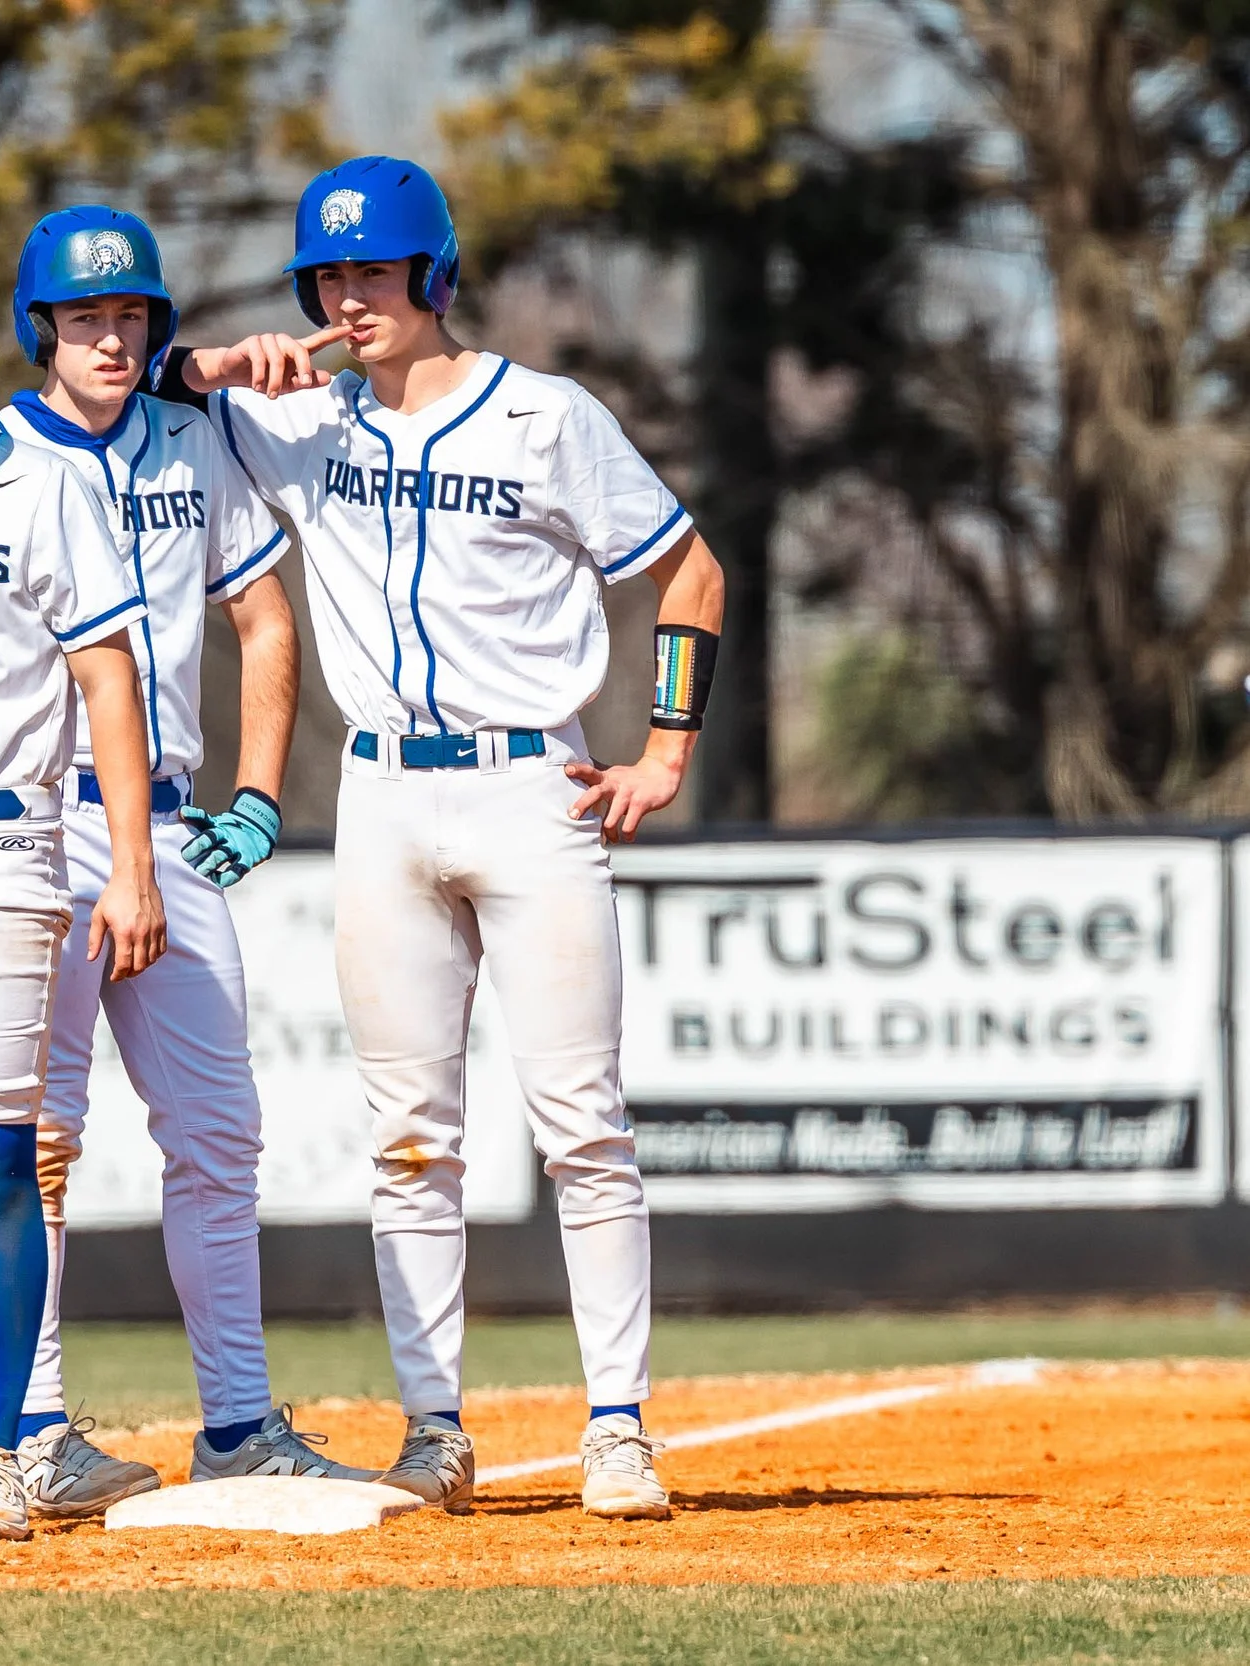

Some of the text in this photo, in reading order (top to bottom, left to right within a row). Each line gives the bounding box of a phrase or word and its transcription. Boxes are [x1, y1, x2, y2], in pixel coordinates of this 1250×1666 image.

[325, 457, 524, 519] WARRIORS
[615, 869, 1179, 972] TruSteel
[669, 1001, 1152, 1056] BUILDINGS
[628, 1106, 790, 1174] merican
